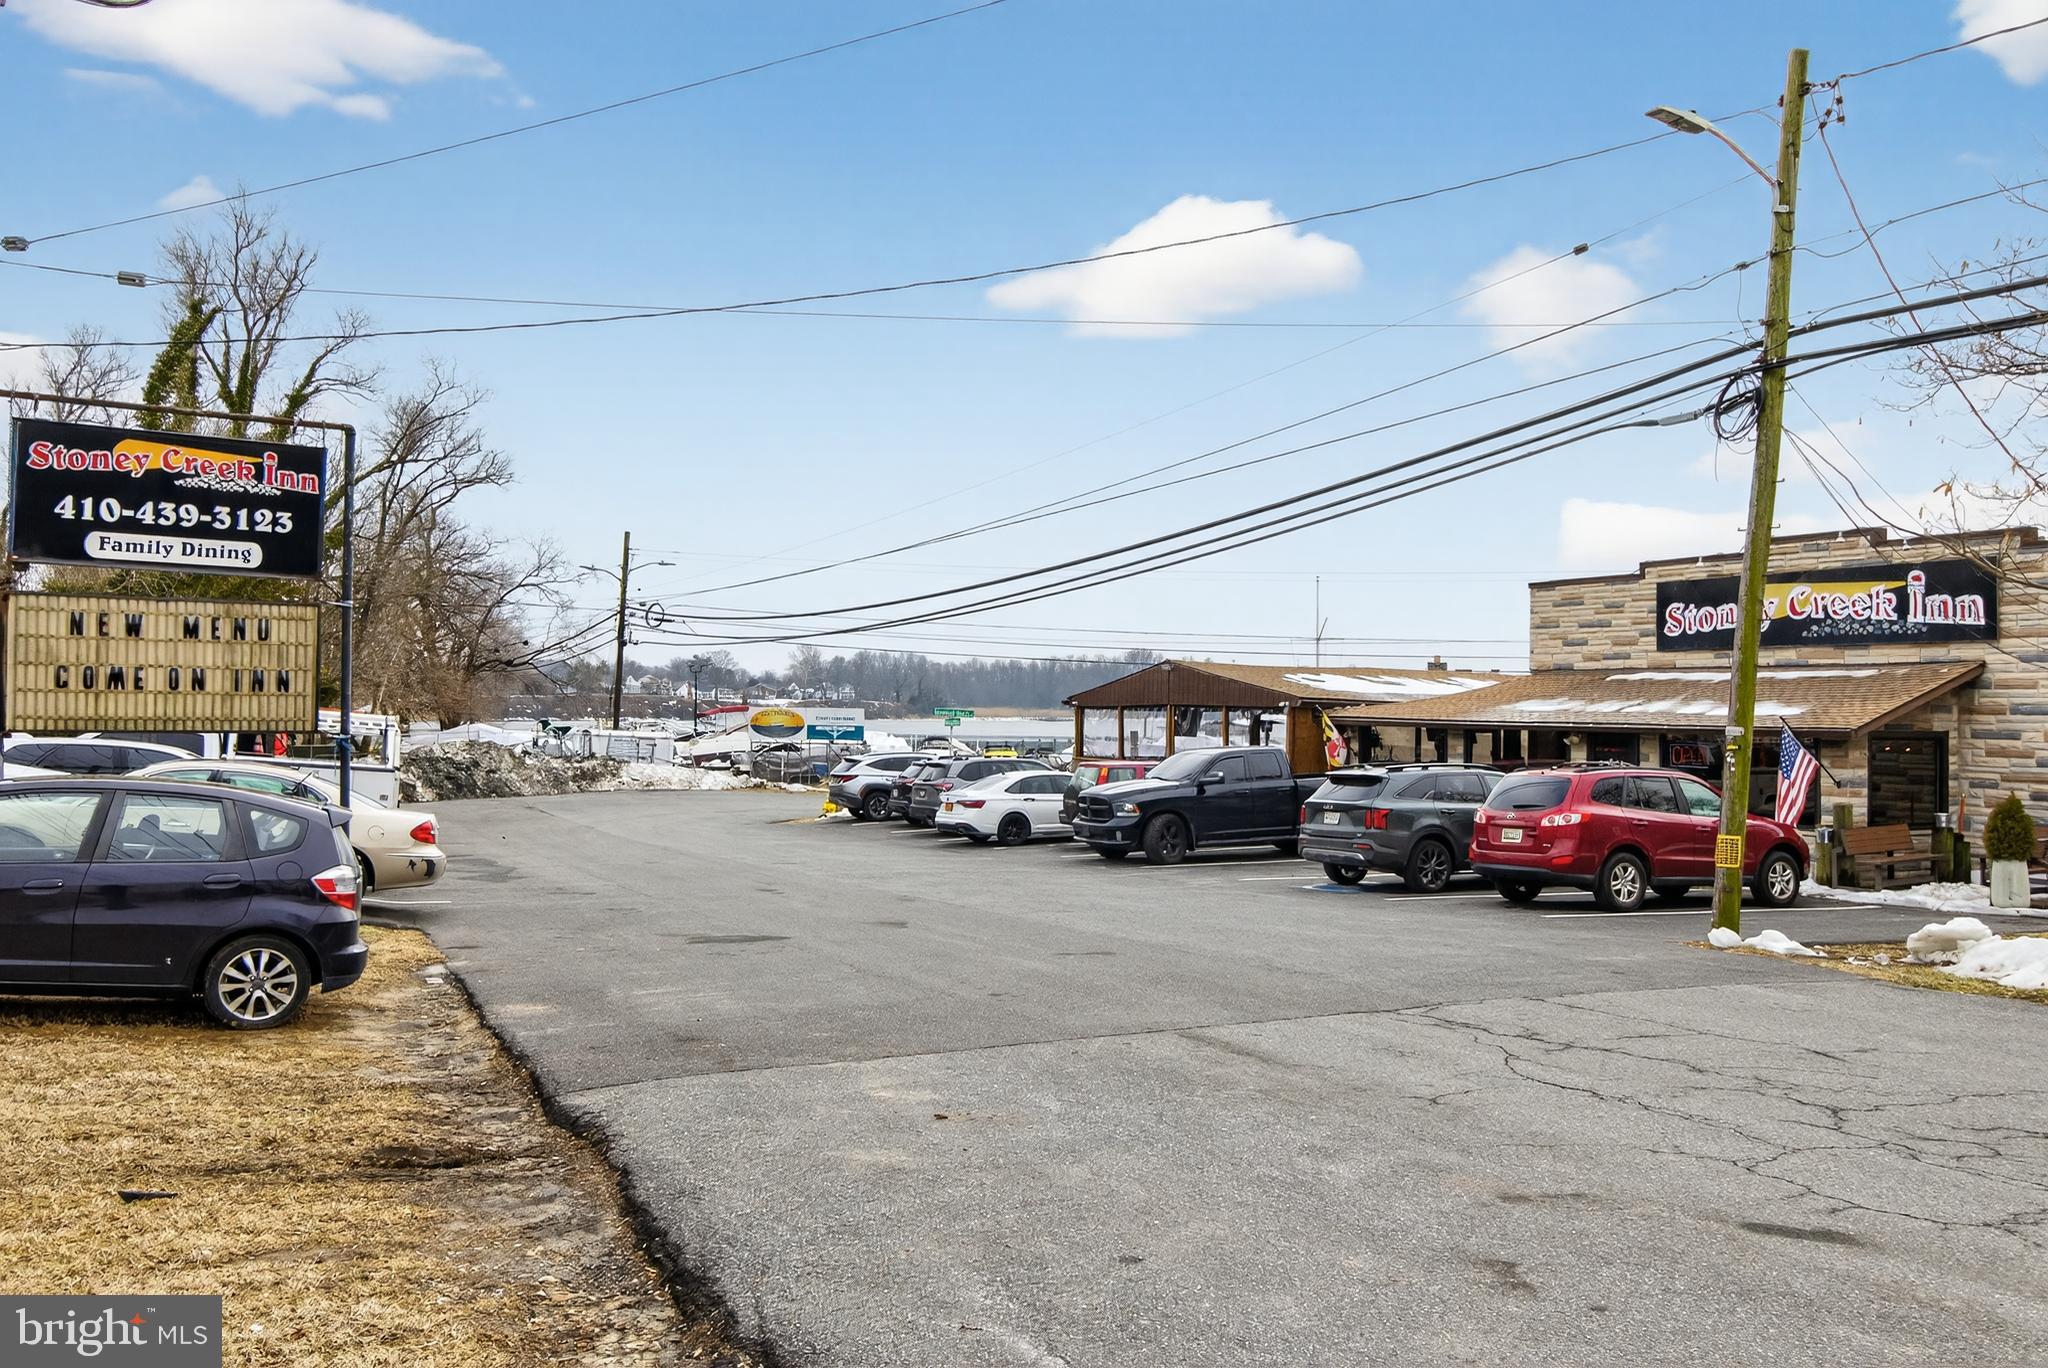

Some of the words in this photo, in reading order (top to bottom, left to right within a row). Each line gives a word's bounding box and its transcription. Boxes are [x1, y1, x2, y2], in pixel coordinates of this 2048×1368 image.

[26, 441, 153, 478] Stoney
[161, 447, 256, 481] Creek
[53, 494, 294, 534] 410-439-3123
[98, 535, 174, 559] Family
[181, 541, 252, 564] Dining
[69, 609, 144, 638] NEW
[183, 615, 270, 641] MENU
[1663, 597, 1780, 637] Stony
[1786, 585, 1898, 621] Creek
[55, 664, 145, 692] COME
[168, 667, 206, 692] ON
[234, 668, 290, 693] INN
